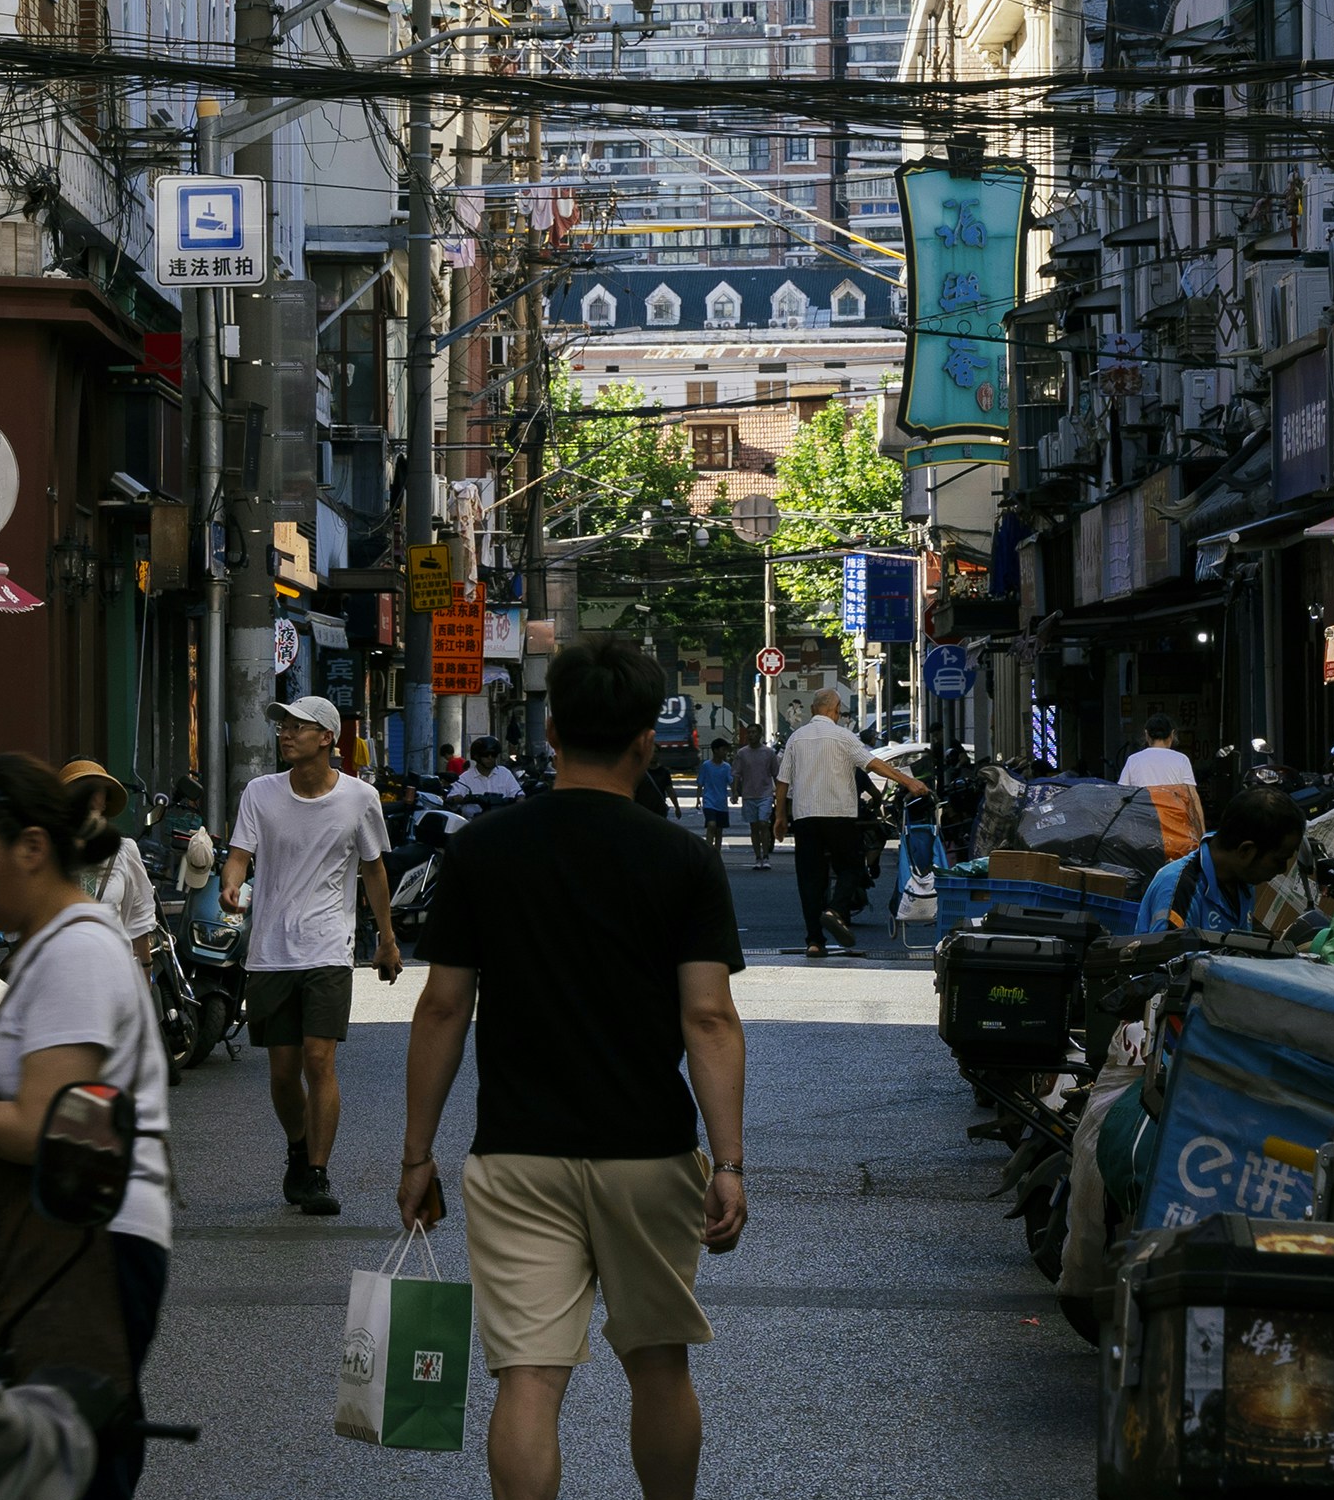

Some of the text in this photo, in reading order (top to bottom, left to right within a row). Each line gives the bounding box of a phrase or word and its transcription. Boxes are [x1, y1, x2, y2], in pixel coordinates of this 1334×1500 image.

[168, 256, 254, 277] 违法抓拍
[435, 603, 479, 618] 北京东路
[434, 663, 479, 675] 道路施工
[760, 652, 781, 671] 停
[326, 657, 355, 708] 宾馆
[433, 678, 479, 690] 车辆慢行
